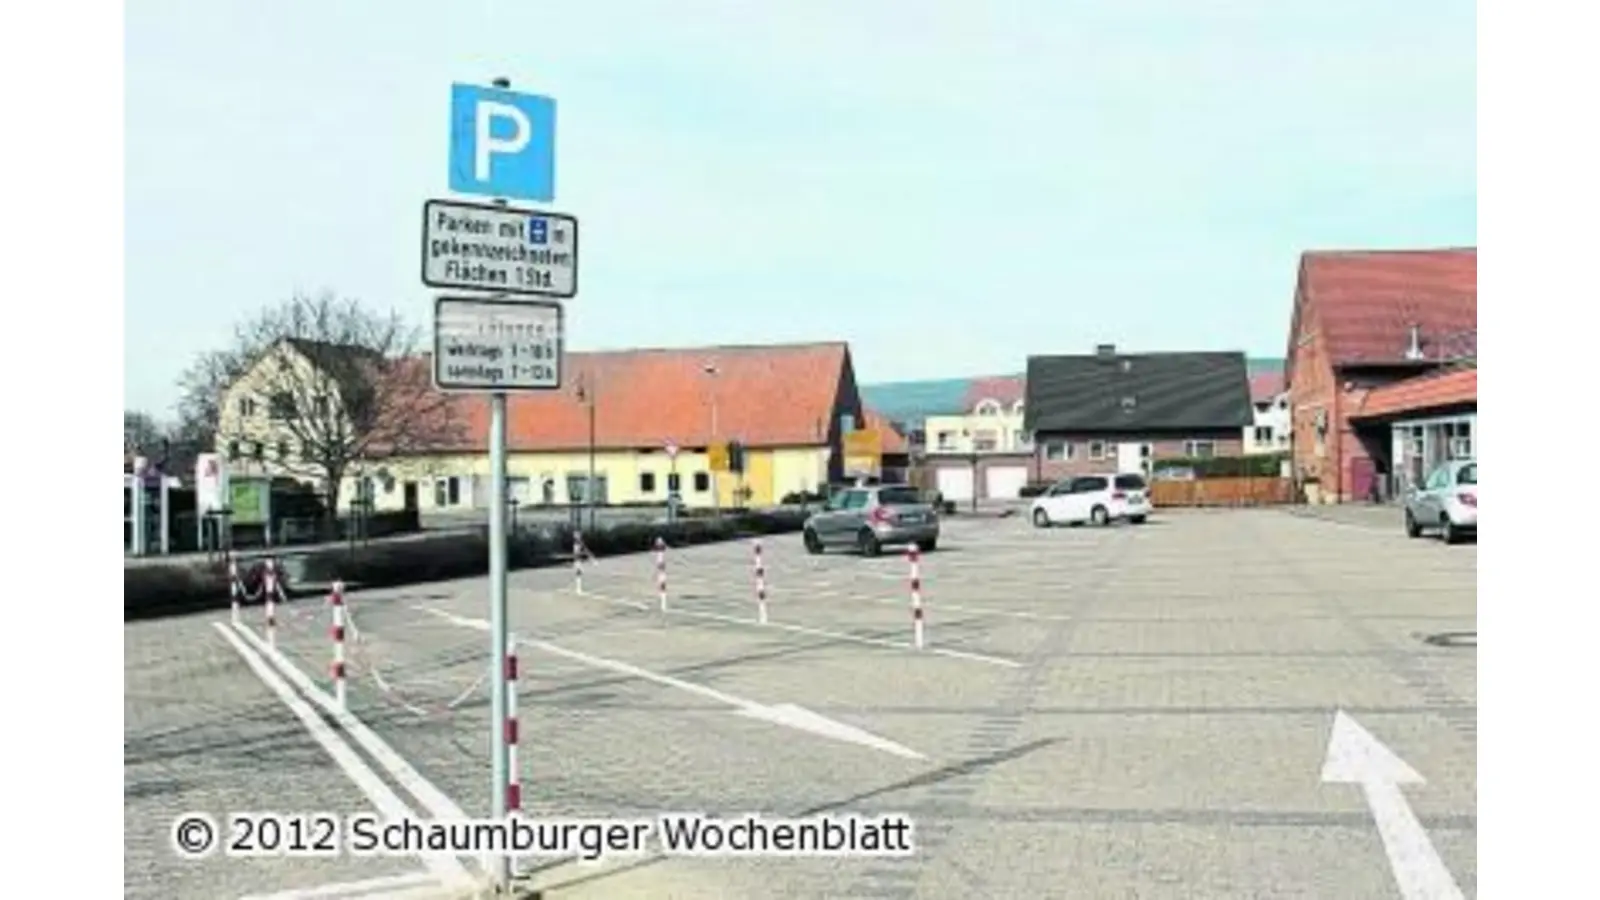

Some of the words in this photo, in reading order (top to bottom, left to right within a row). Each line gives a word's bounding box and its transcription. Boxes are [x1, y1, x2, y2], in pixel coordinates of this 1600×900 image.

[475, 101, 532, 181] P
[437, 211, 493, 234] Parken
[499, 219, 524, 240] mit
[445, 259, 508, 285] Flächen
